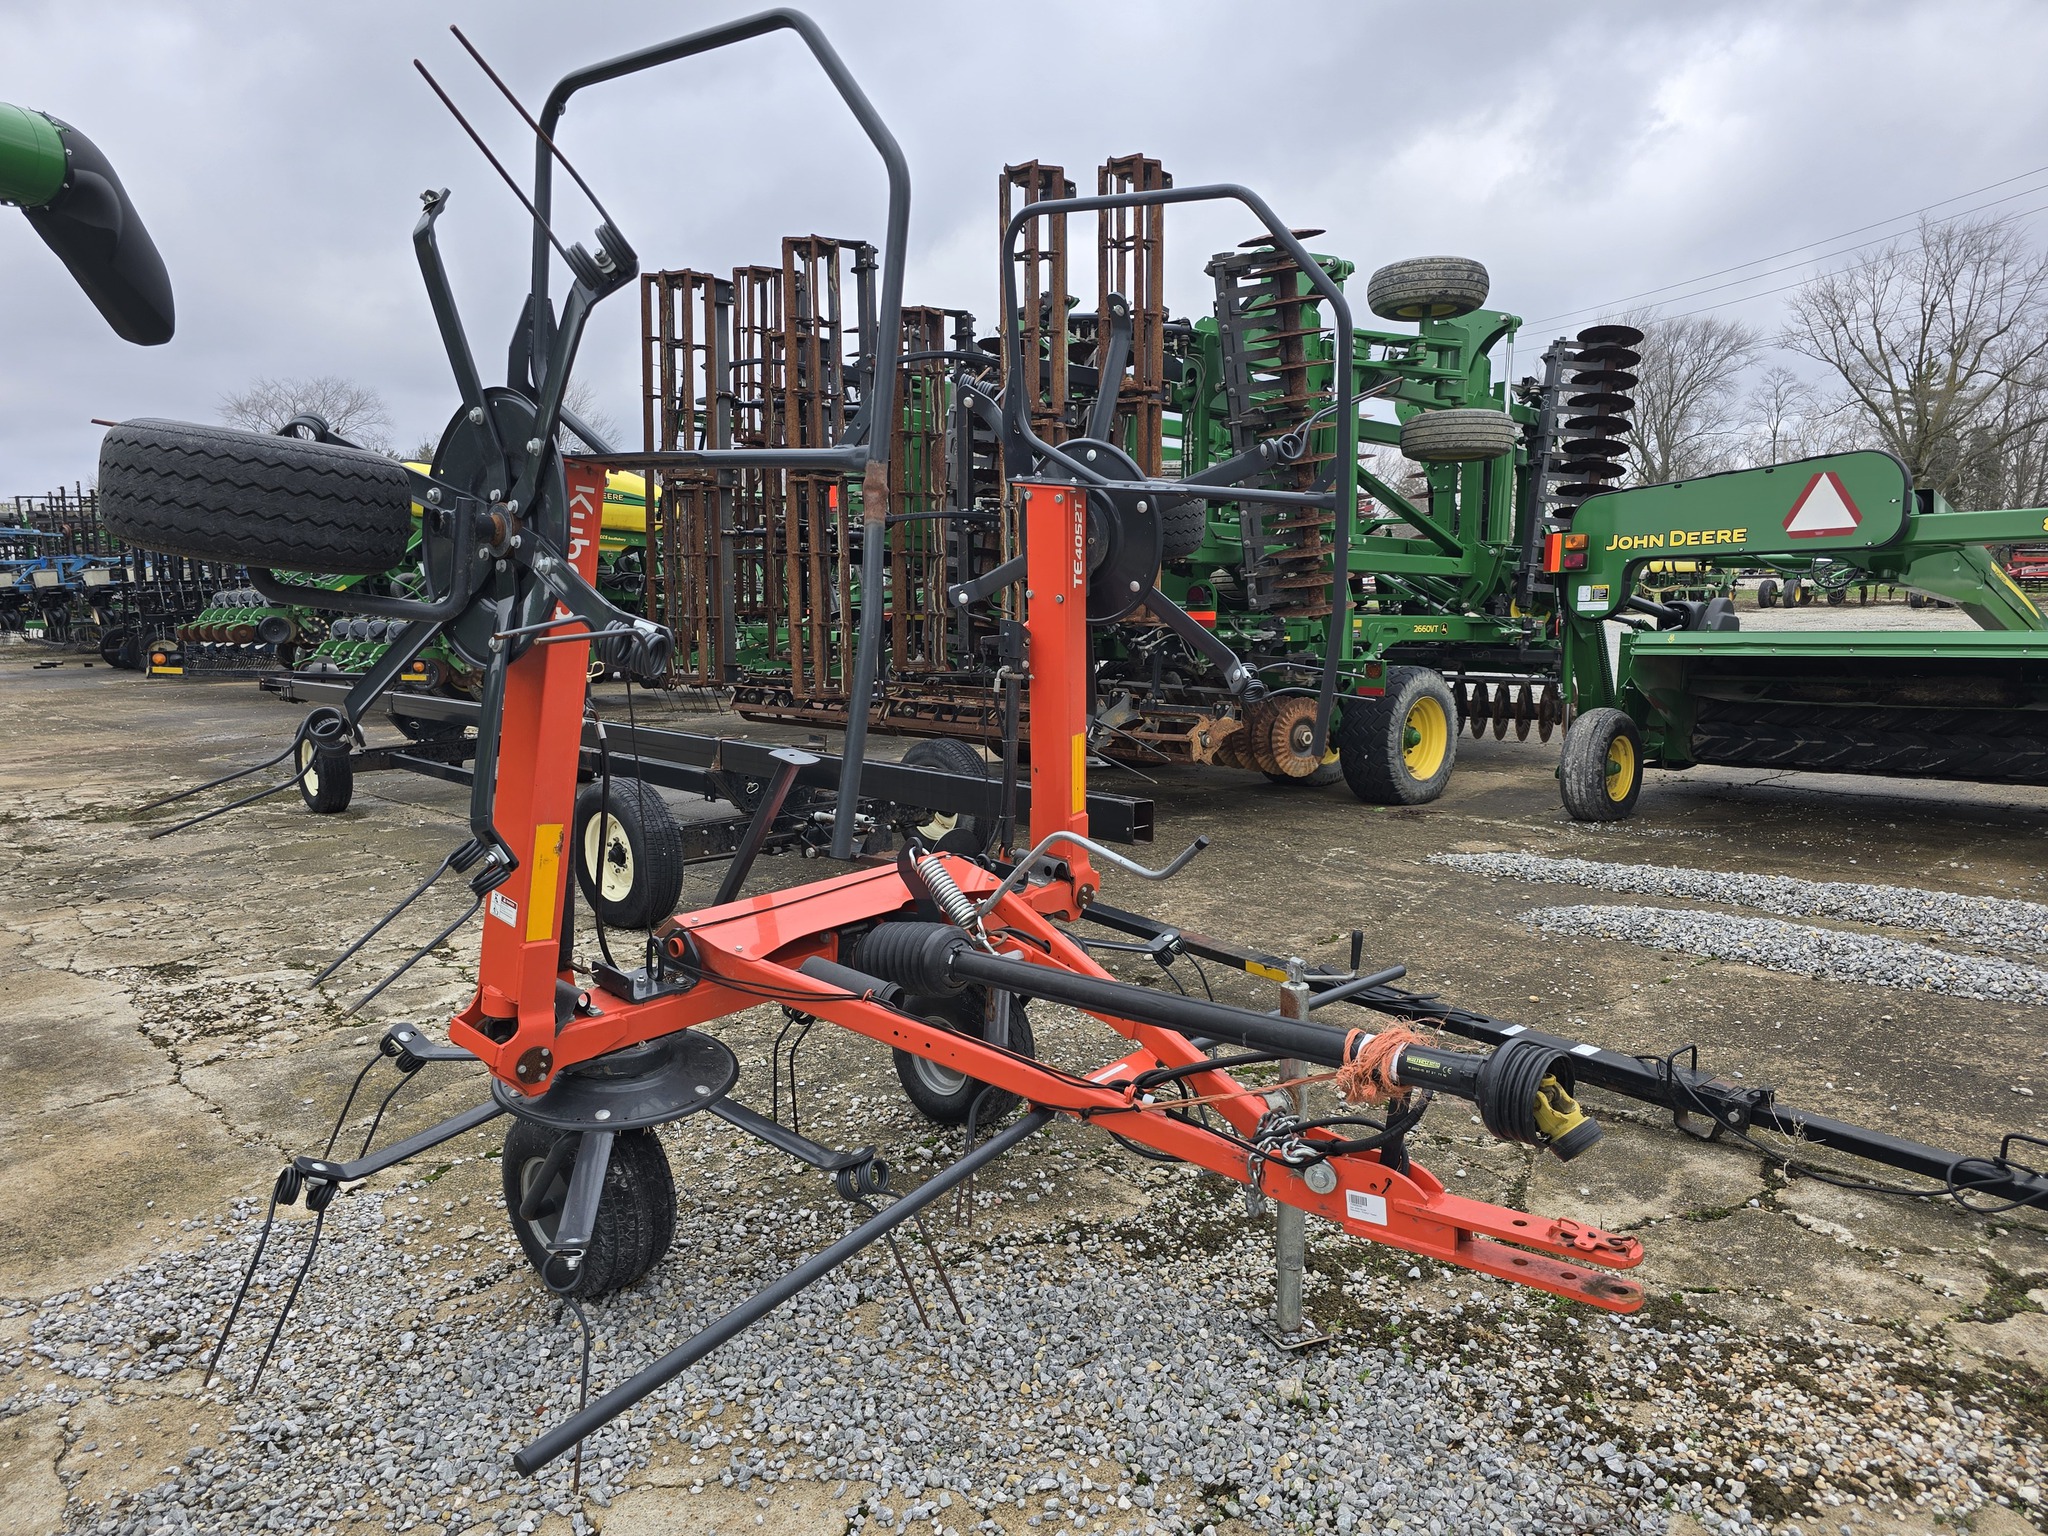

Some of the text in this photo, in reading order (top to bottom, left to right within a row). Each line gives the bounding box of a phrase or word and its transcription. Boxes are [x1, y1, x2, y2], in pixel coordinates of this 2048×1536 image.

[603, 492, 624, 501] EERE
[1073, 500, 1083, 588] TE4052T
[1605, 528, 1748, 551] JOHN DEERE
[555, 485, 595, 620] Kuba
[1413, 624, 1439, 633] 2660VT
